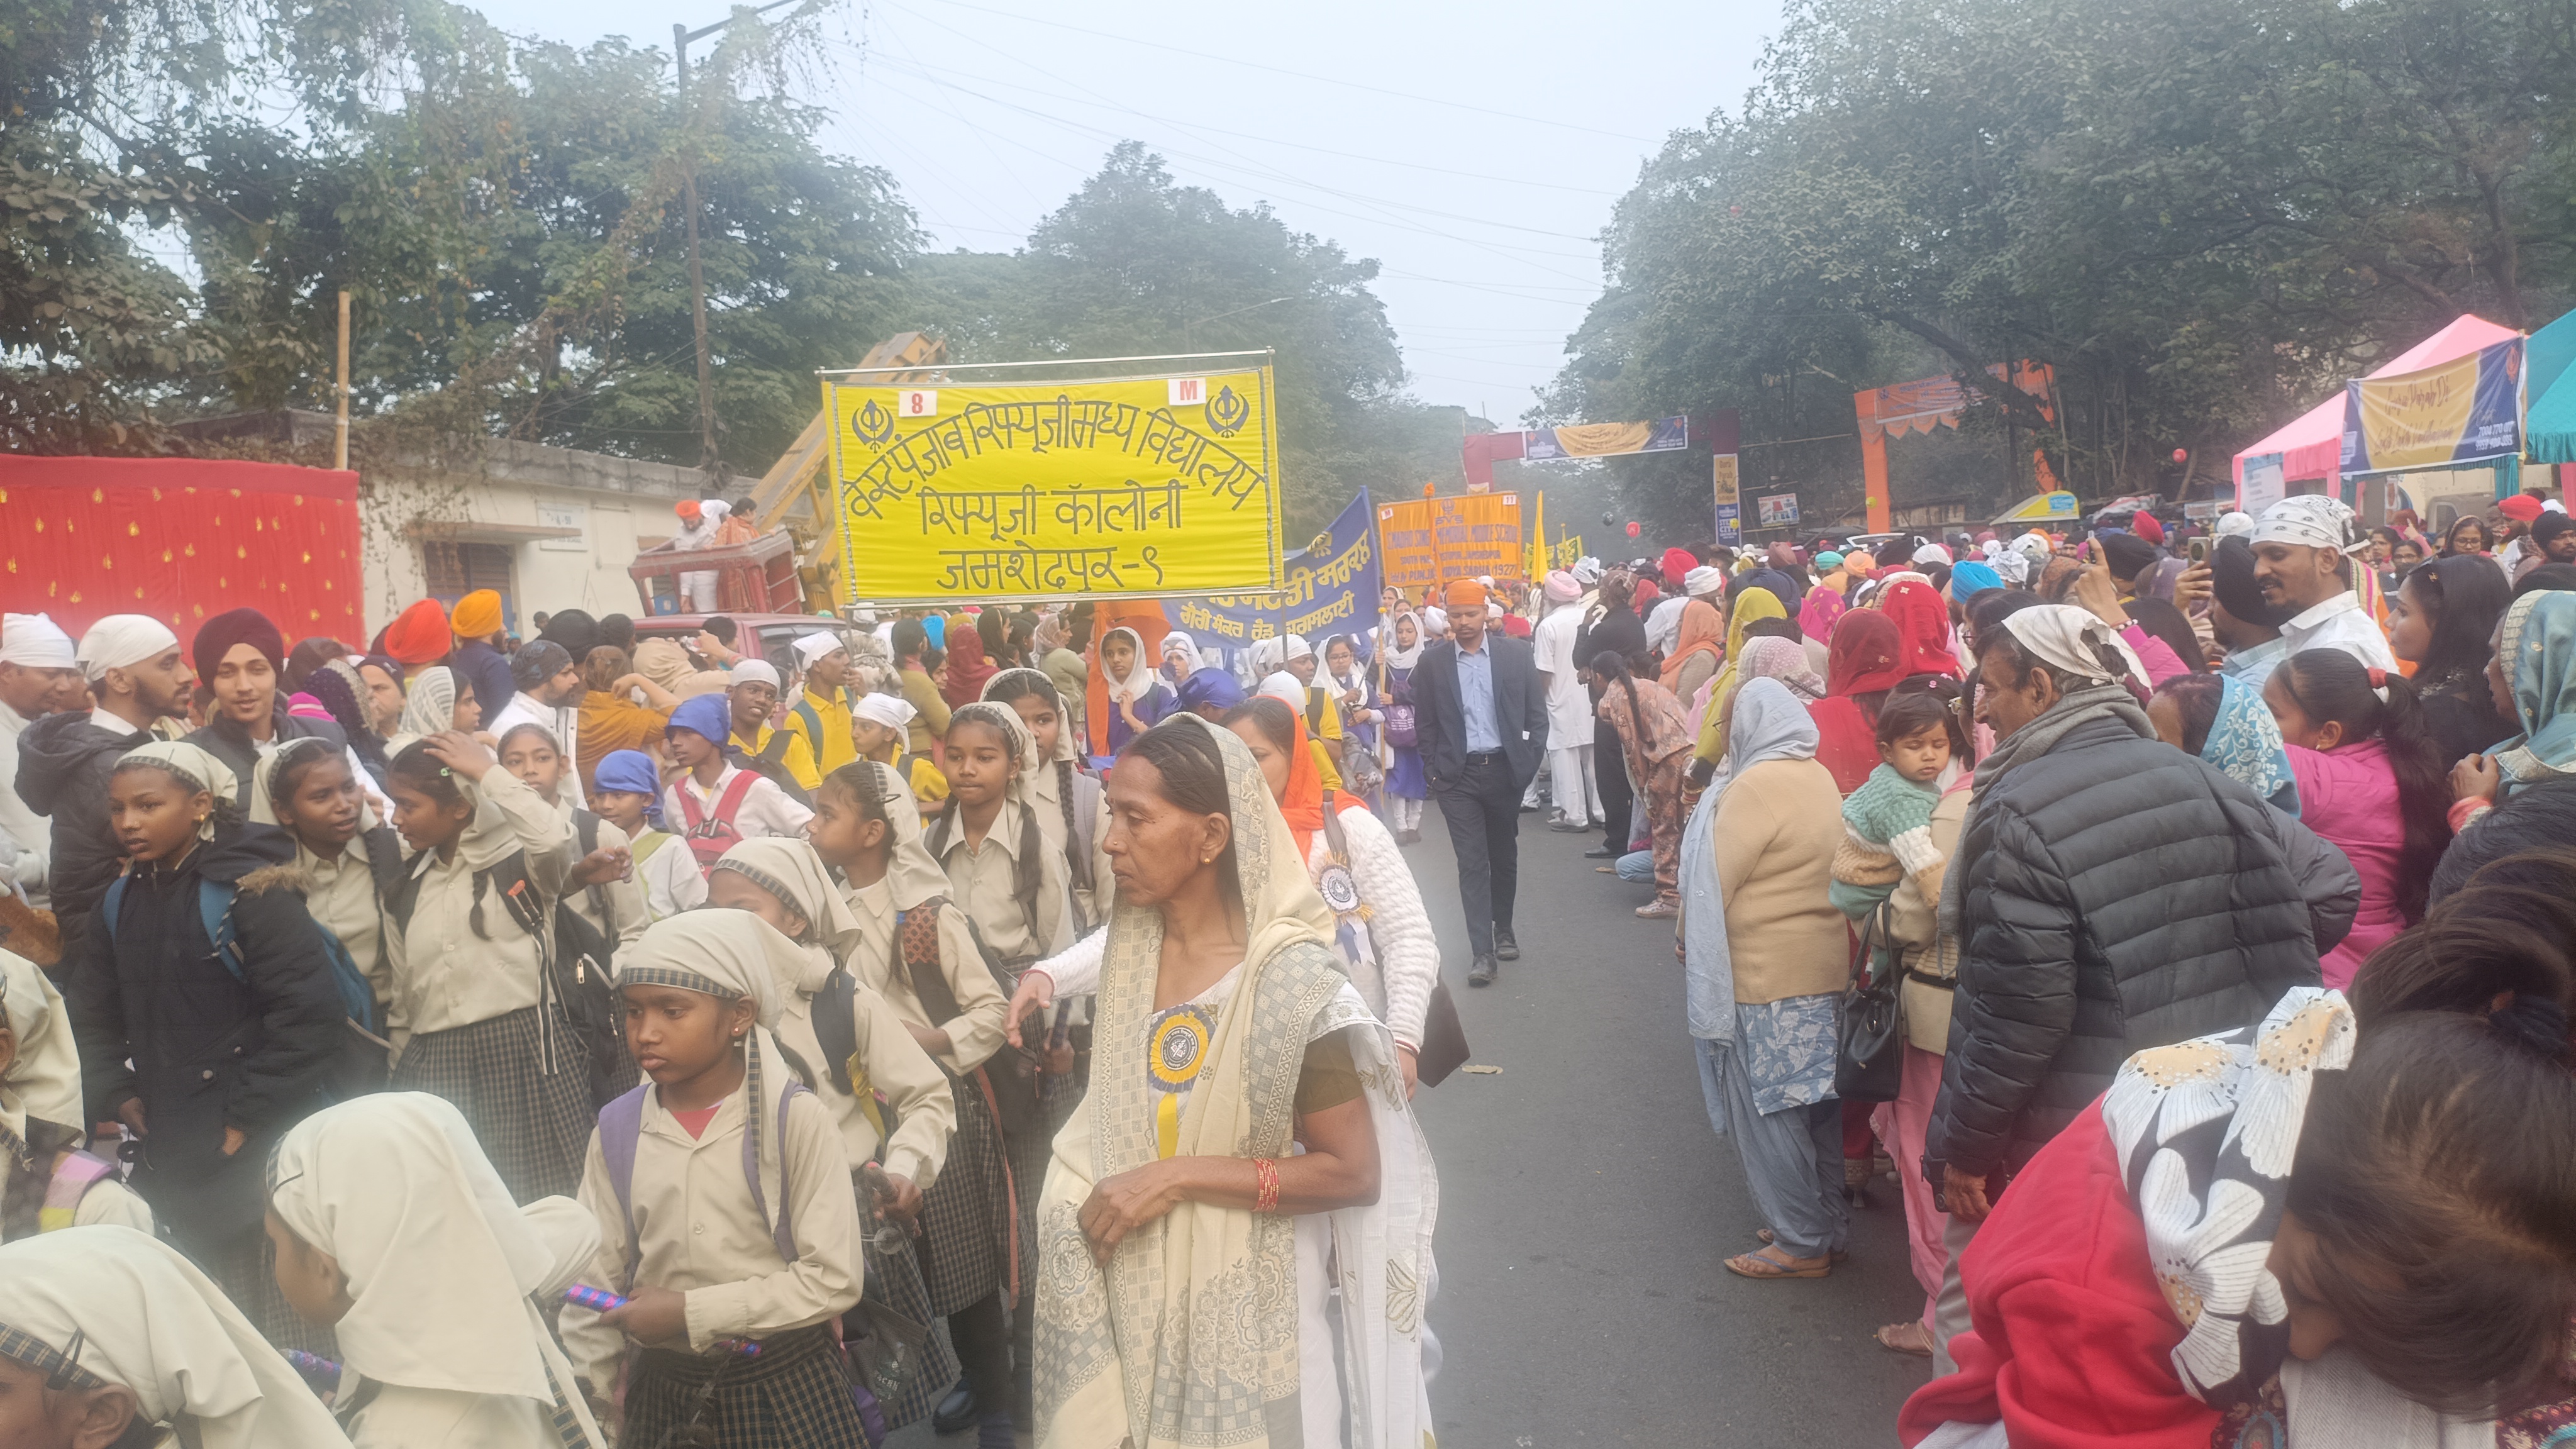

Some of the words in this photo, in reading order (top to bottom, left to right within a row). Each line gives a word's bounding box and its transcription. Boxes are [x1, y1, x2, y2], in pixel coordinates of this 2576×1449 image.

[1179, 380, 1197, 401] M
[911, 392, 923, 414] 8
[886, 413, 970, 482] पंजाब
[1071, 400, 1141, 453] मध्य
[1136, 408, 1267, 511] विद्यालय
[916, 483, 1047, 542] रिफ्यूजी
[1051, 479, 1189, 535] कॉलोनी
[1409, 568, 1435, 582] PUNJA
